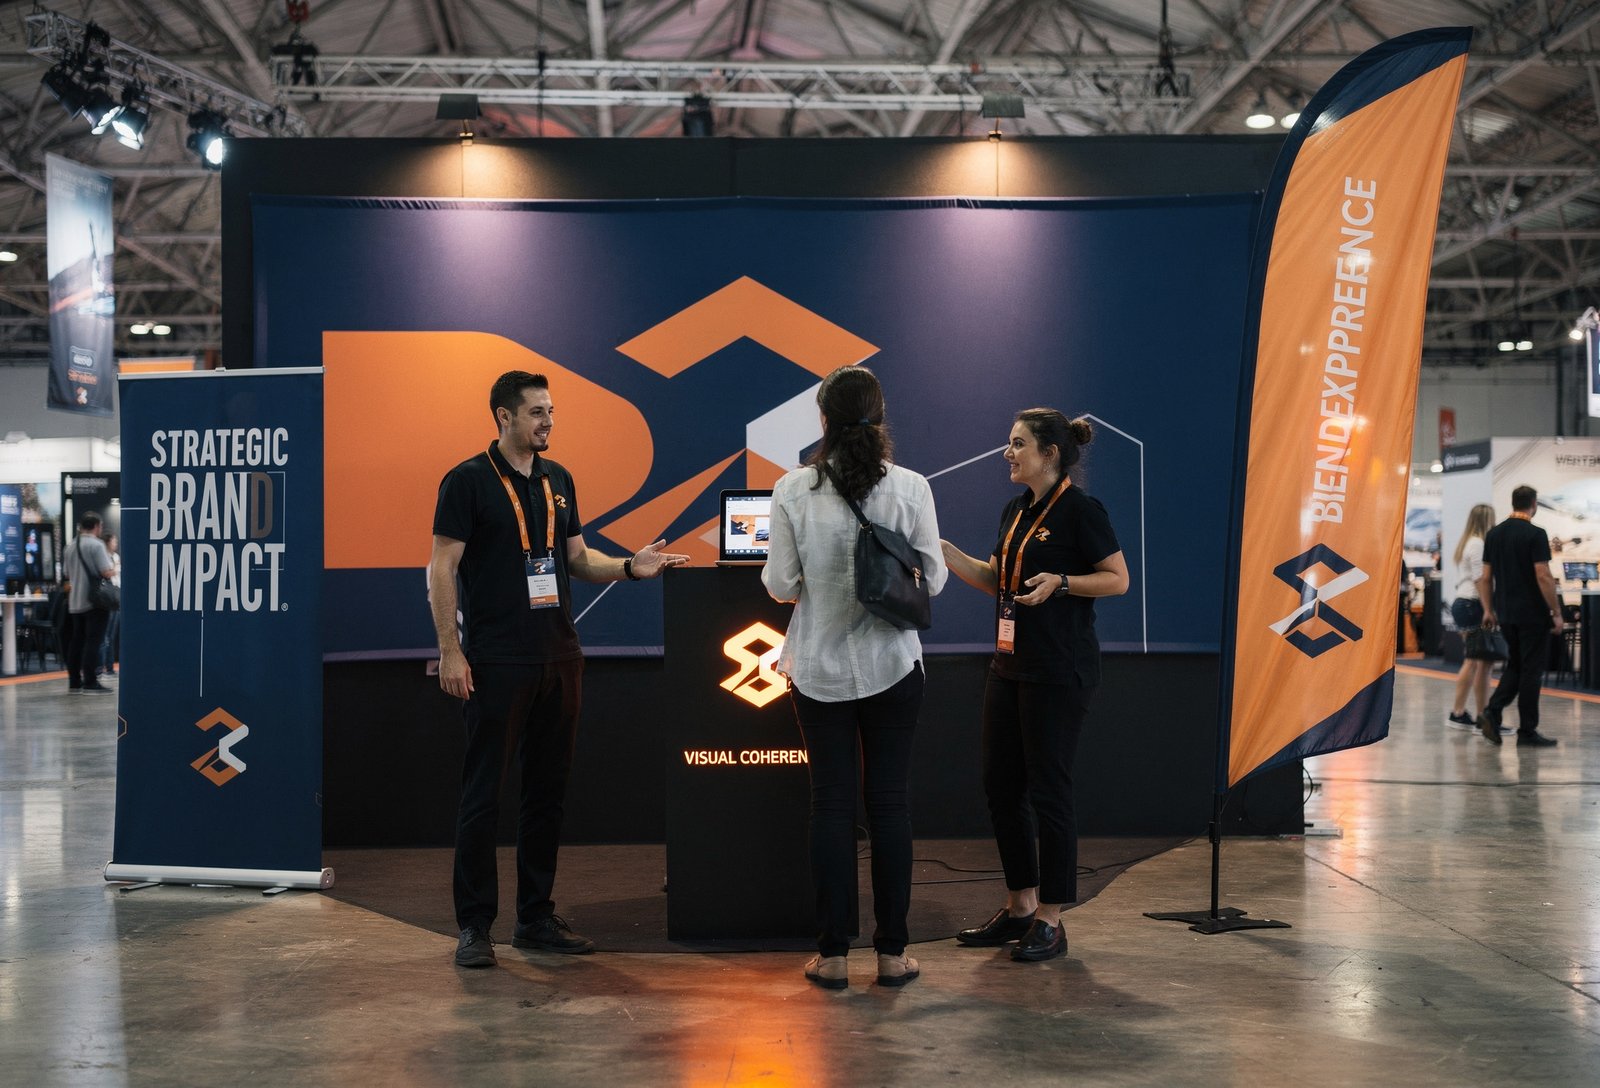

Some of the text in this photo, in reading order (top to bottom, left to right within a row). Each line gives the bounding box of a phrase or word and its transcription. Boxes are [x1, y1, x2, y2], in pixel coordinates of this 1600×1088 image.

[150, 427, 289, 468] STRATEGIC
[149, 471, 274, 541] BRAND
[684, 749, 808, 765] VISUAL COHEREN
